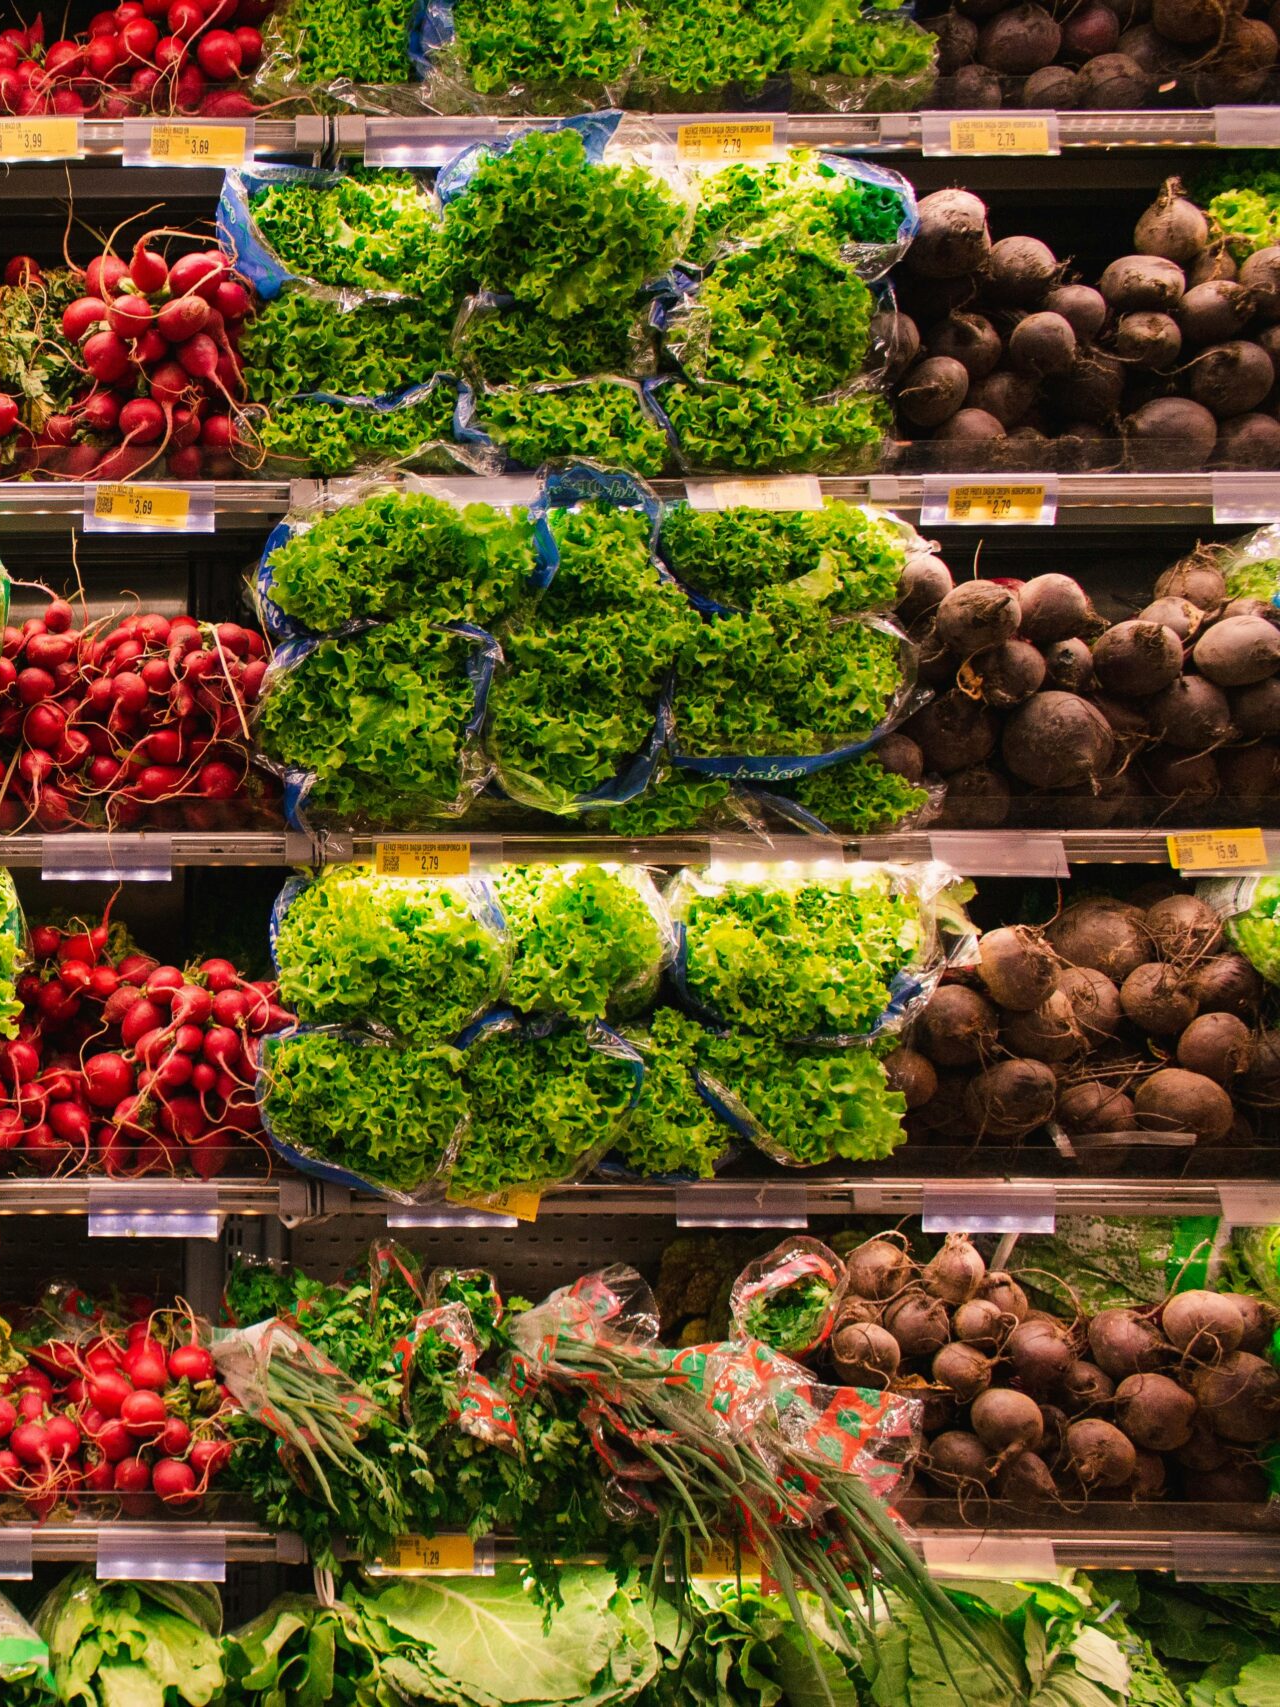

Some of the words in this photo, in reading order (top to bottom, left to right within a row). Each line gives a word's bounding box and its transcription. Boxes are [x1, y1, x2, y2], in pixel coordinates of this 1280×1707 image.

[24, 133, 42, 149] 3,99
[191, 139, 209, 155] 3,69
[723, 138, 742, 153] 2,79
[997, 133, 1016, 147] 2,79
[134, 499, 153, 515] 3,69
[992, 500, 1011, 514] 2,79
[421, 855, 439, 871] 2,79
[422, 1551, 440, 1567] 1,29
